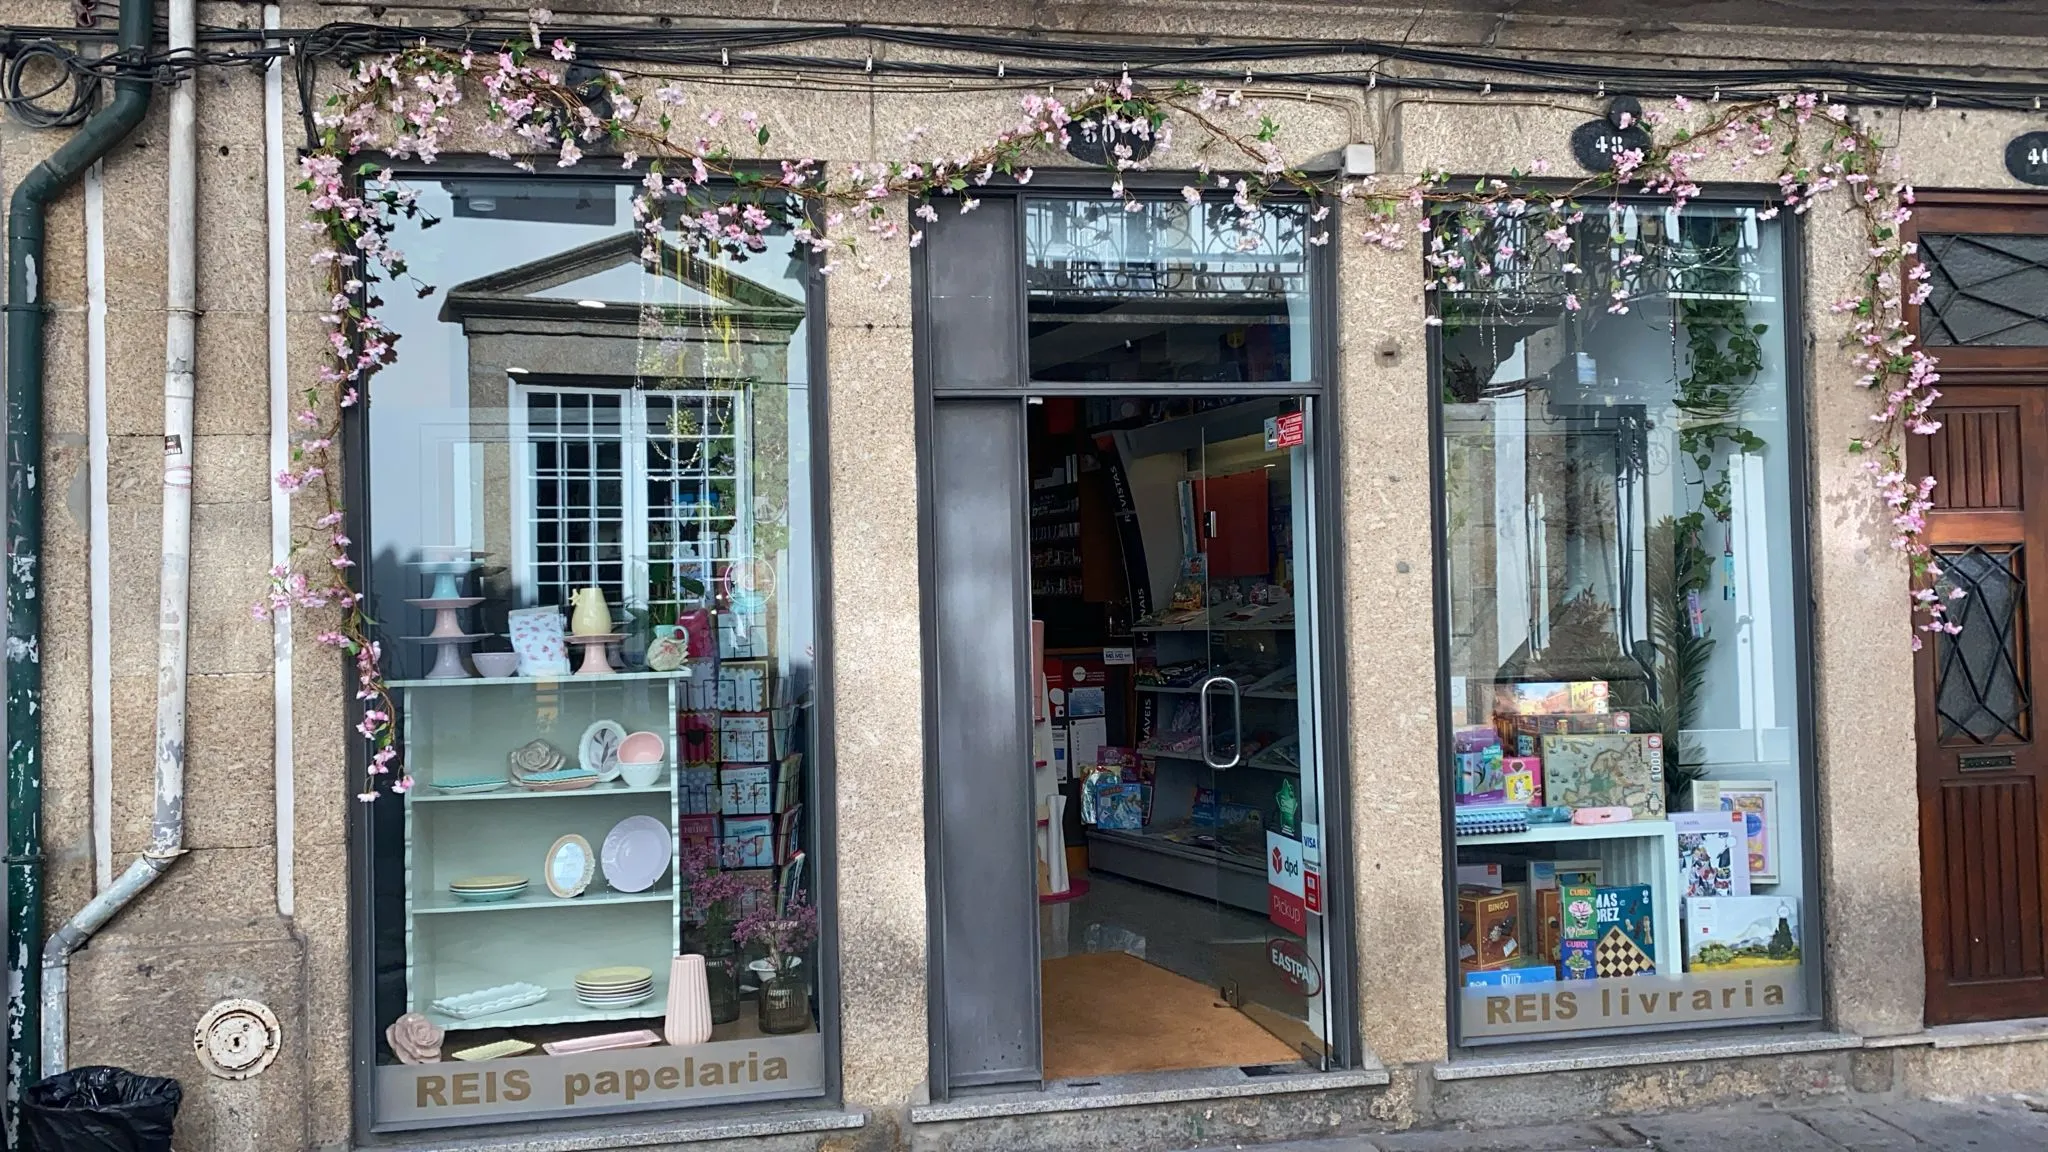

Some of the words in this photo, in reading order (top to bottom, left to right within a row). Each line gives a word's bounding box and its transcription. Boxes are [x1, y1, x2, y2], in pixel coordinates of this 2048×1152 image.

[1595, 136, 1623, 153] 48
[1303, 836, 1317, 849] VISA
[1284, 855, 1299, 877] dpd
[1273, 895, 1301, 924] Pickup
[1488, 900, 1509, 912] BINGO
[1271, 948, 1317, 986] EASTPAK
[1487, 991, 1578, 1025] REIS
[1602, 980, 1784, 1016] livraria
[416, 1069, 531, 1108] REIS
[564, 1051, 788, 1105] papelaria
